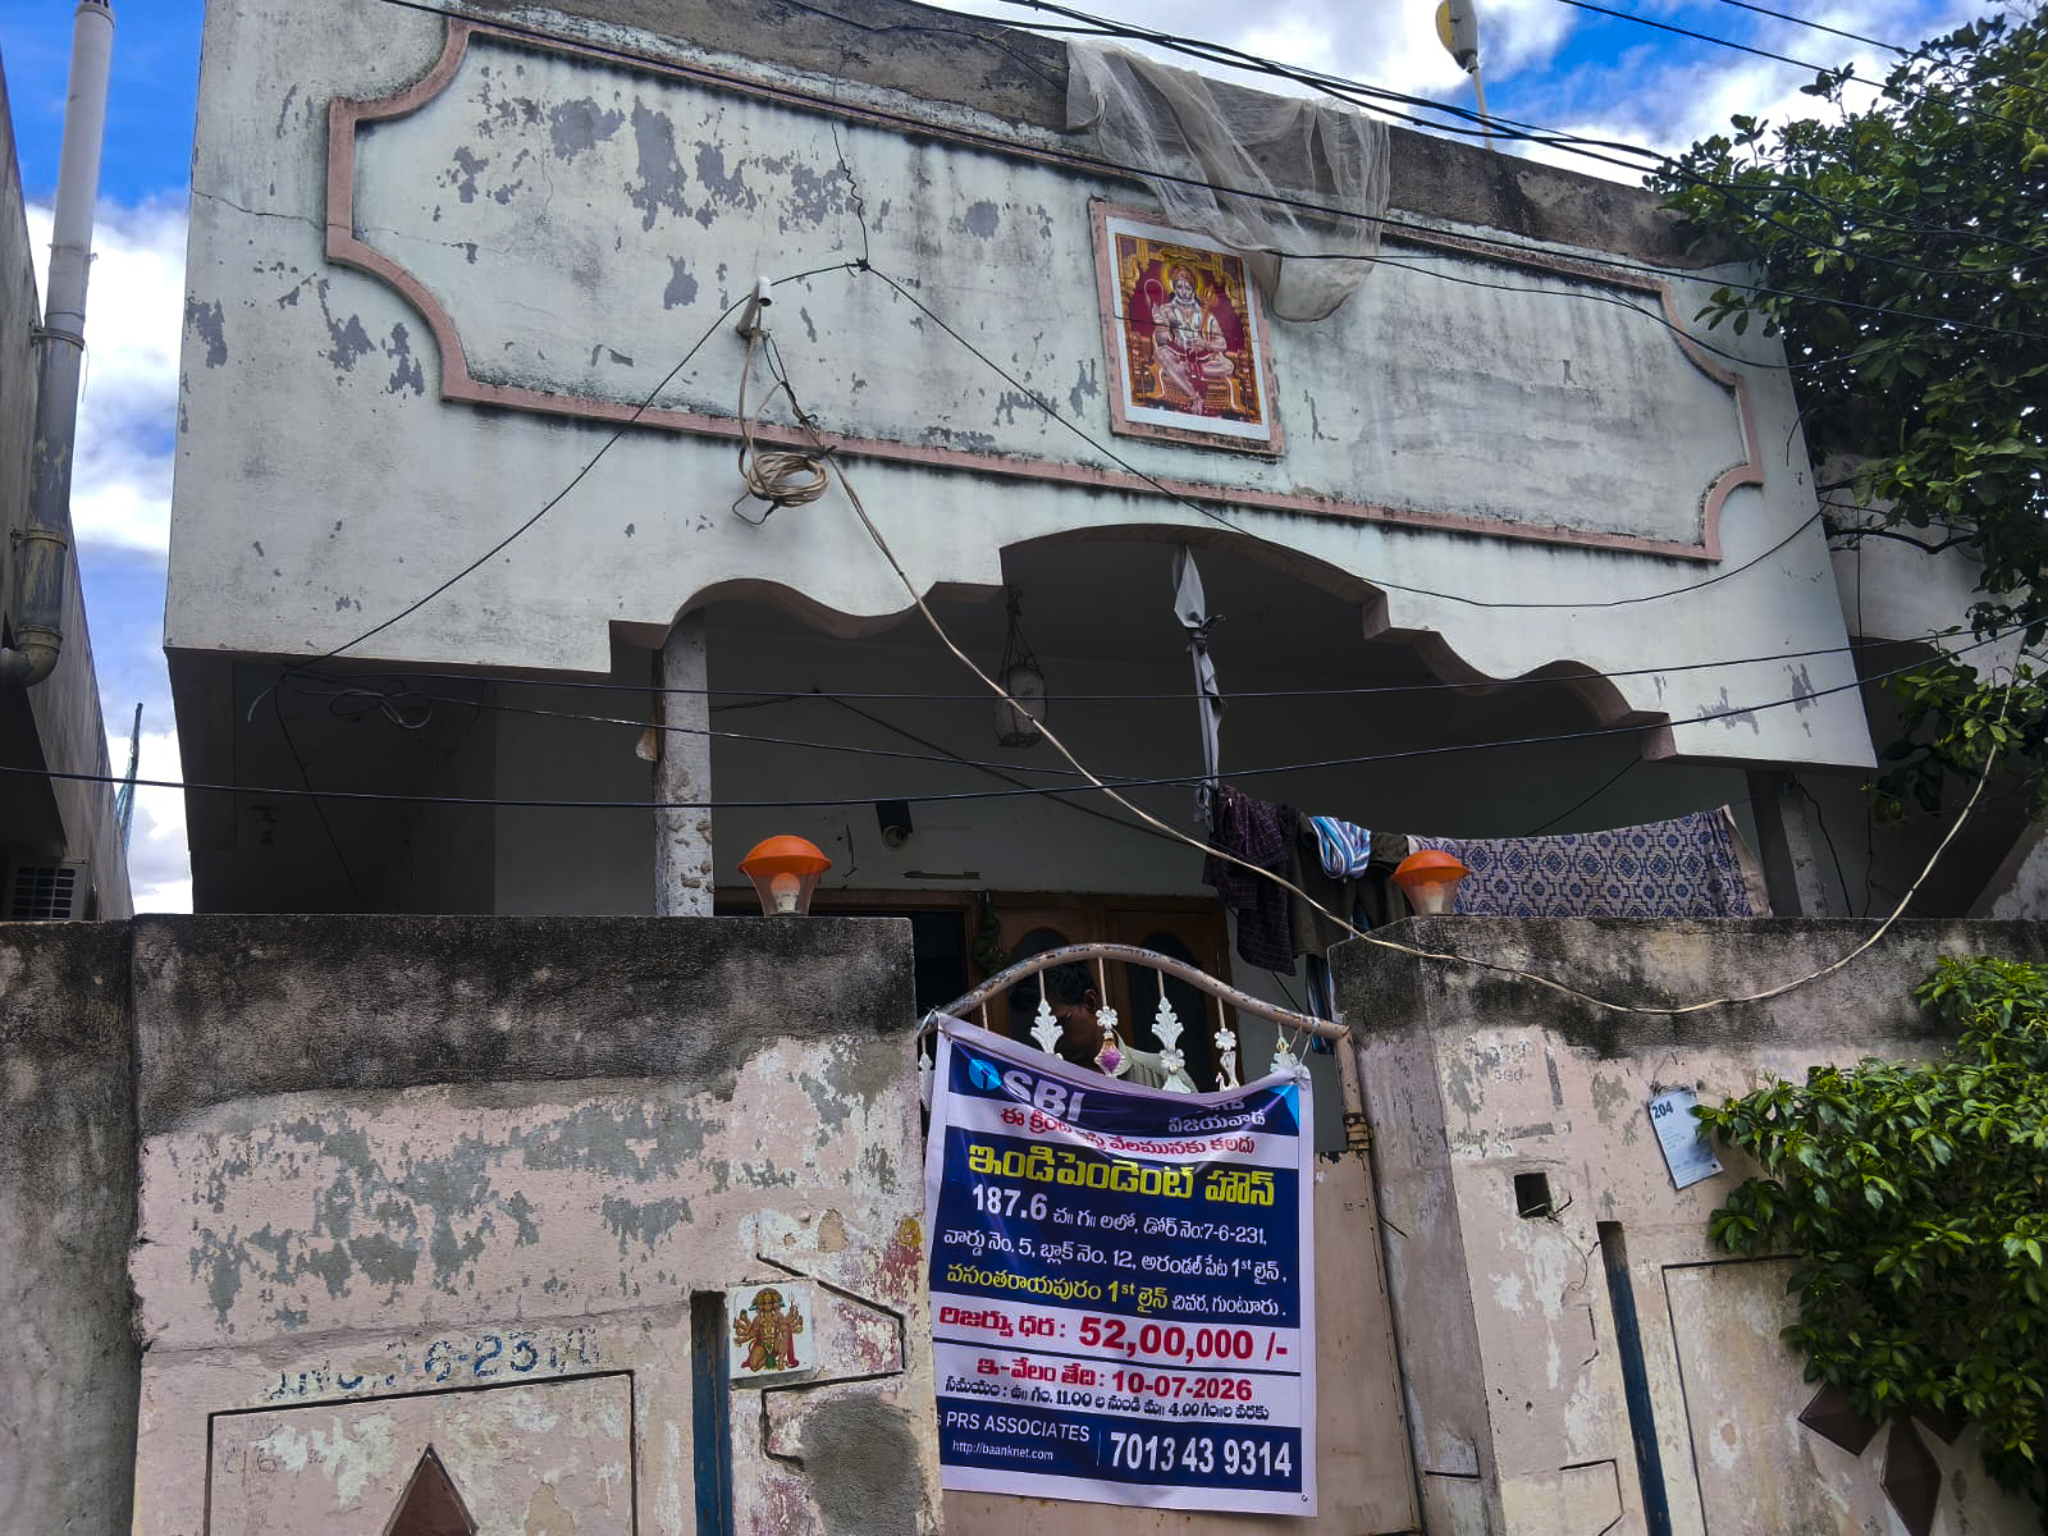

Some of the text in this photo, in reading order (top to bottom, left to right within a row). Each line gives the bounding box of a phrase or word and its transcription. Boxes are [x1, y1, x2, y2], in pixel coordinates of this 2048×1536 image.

[1003, 1069, 1086, 1122] SBI
[1652, 1100, 1674, 1120] 204
[1001, 1107, 1024, 1126] ఈ
[972, 1183, 1048, 1221] 187.6
[1205, 1169, 1275, 1206] హౌస్
[1112, 1250, 1136, 1270] 12,
[1078, 1315, 1254, 1363] 52,00,000
[1111, 1369, 1253, 1401] 10-07-2026
[1168, 1402, 1199, 1418] 4.00
[946, 1411, 980, 1431] PRS
[984, 1415, 1091, 1443] ASSOCIATES
[952, 1439, 1055, 1461] http://baanknet.com
[1110, 1431, 1293, 1478] 7013 43 9314
